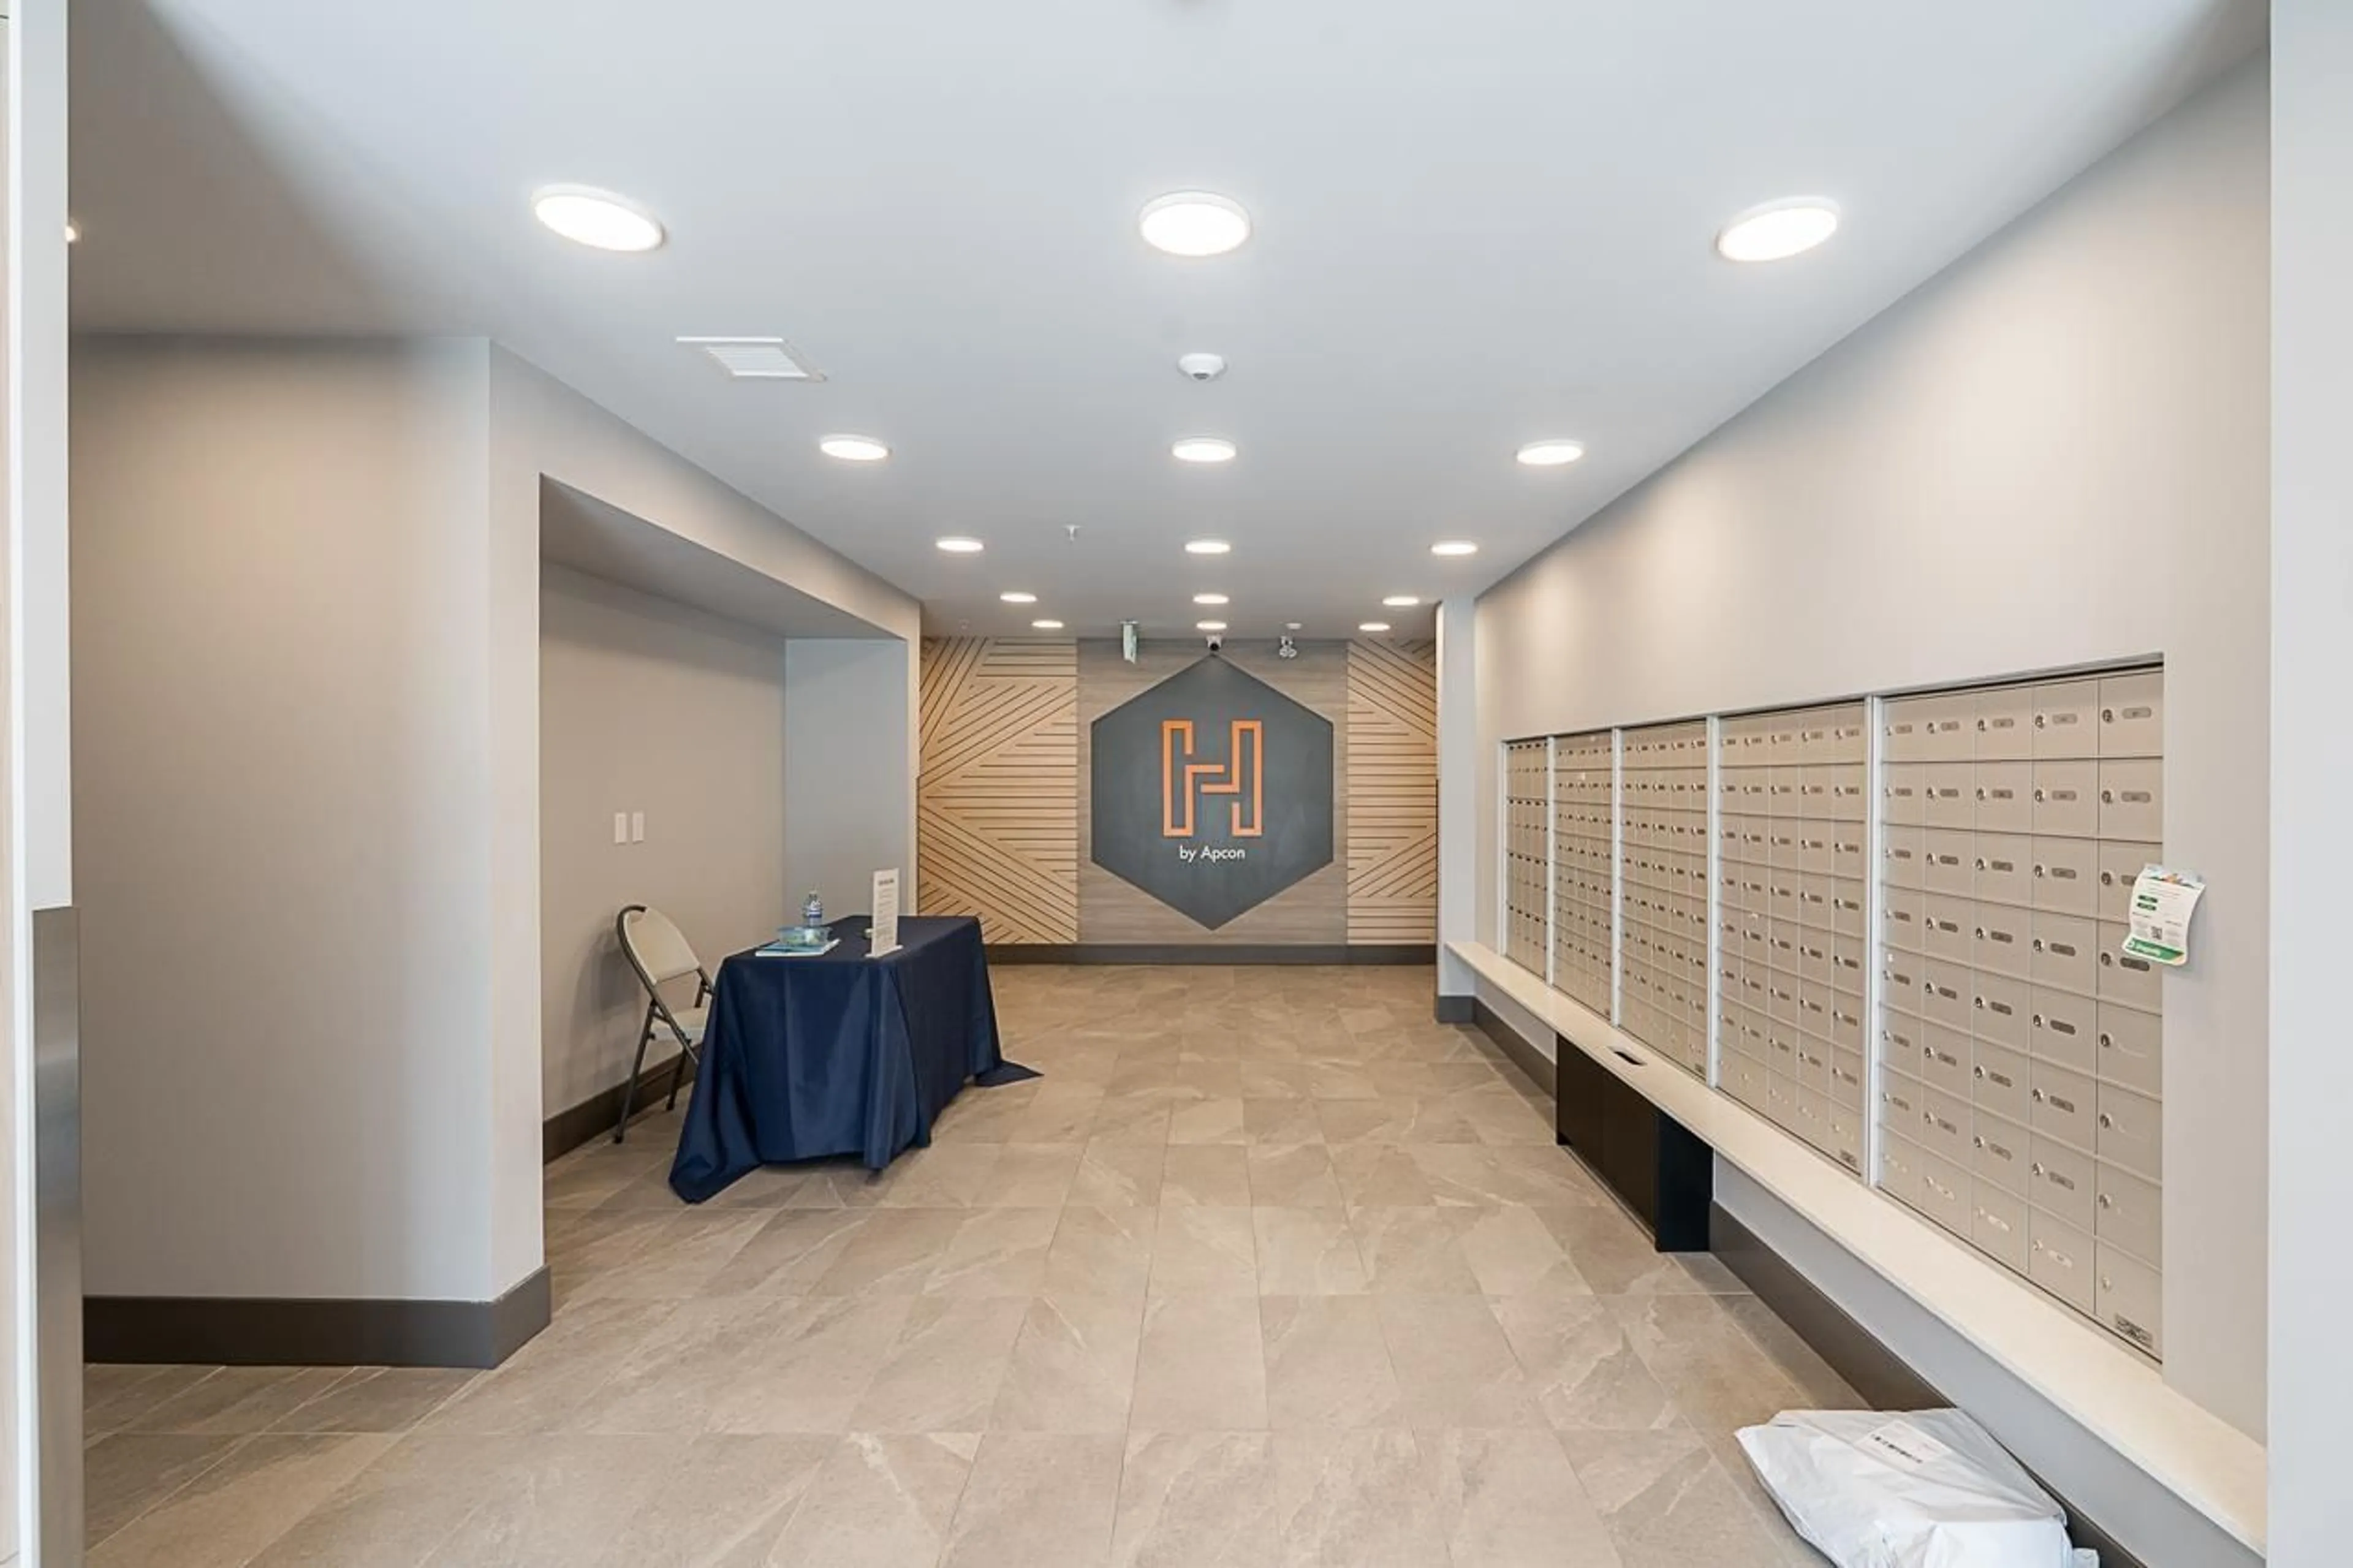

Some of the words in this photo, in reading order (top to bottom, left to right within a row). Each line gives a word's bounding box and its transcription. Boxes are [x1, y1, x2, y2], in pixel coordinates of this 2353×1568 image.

[1162, 720, 1262, 837] H
[1180, 844, 1197, 863] by
[1200, 845, 1246, 863] Apcon
